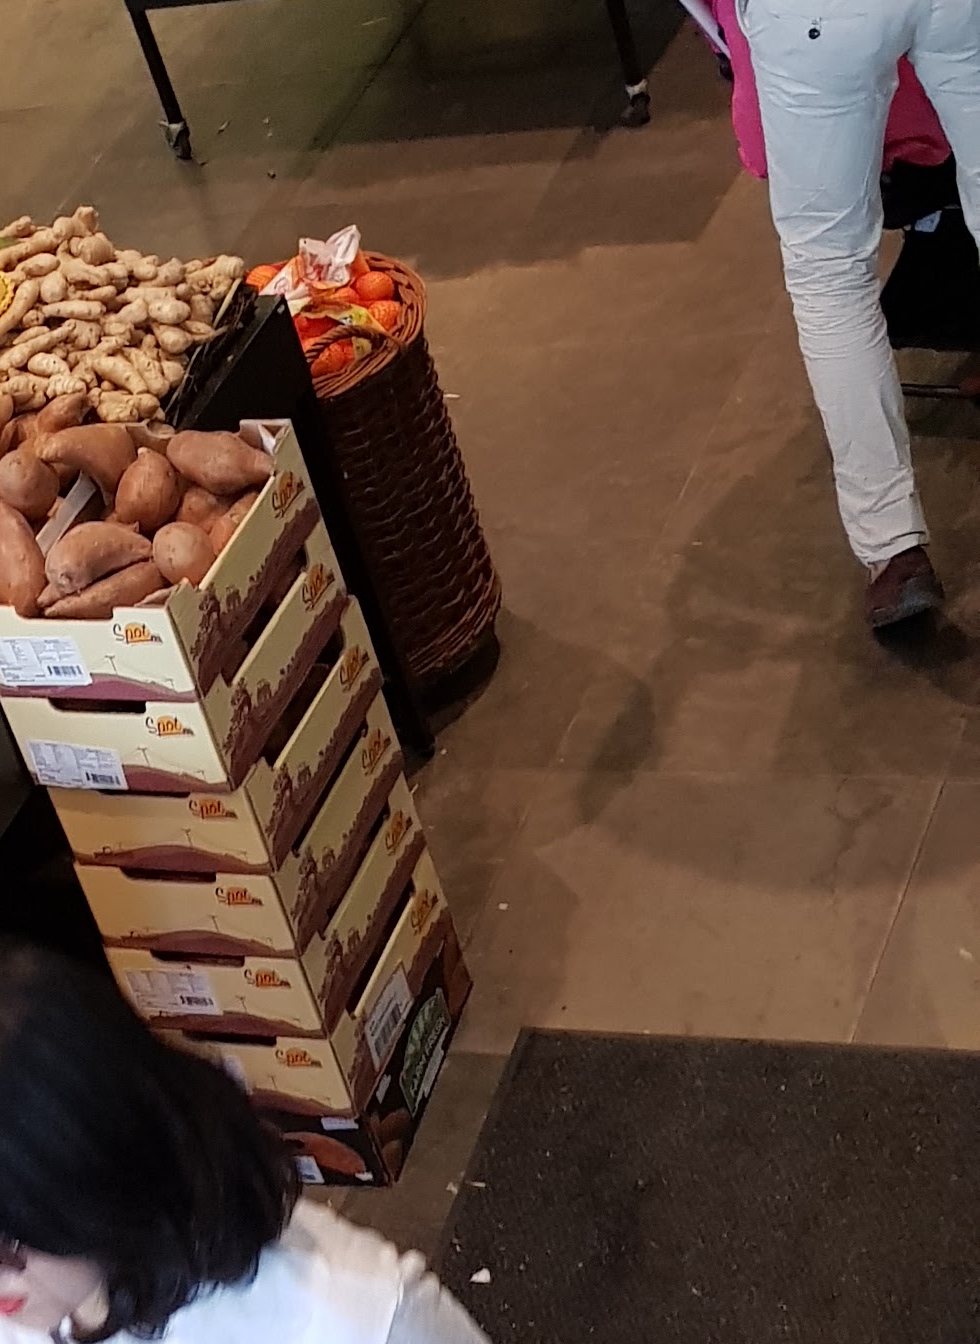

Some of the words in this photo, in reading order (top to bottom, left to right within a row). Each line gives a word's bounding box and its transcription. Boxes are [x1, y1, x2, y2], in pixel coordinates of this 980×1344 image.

[113, 622, 150, 644] Spot
[146, 716, 182, 737] Spot
[189, 798, 225, 819] Spot
[216, 887, 252, 906] Spot
[244, 968, 281, 987] Spot
